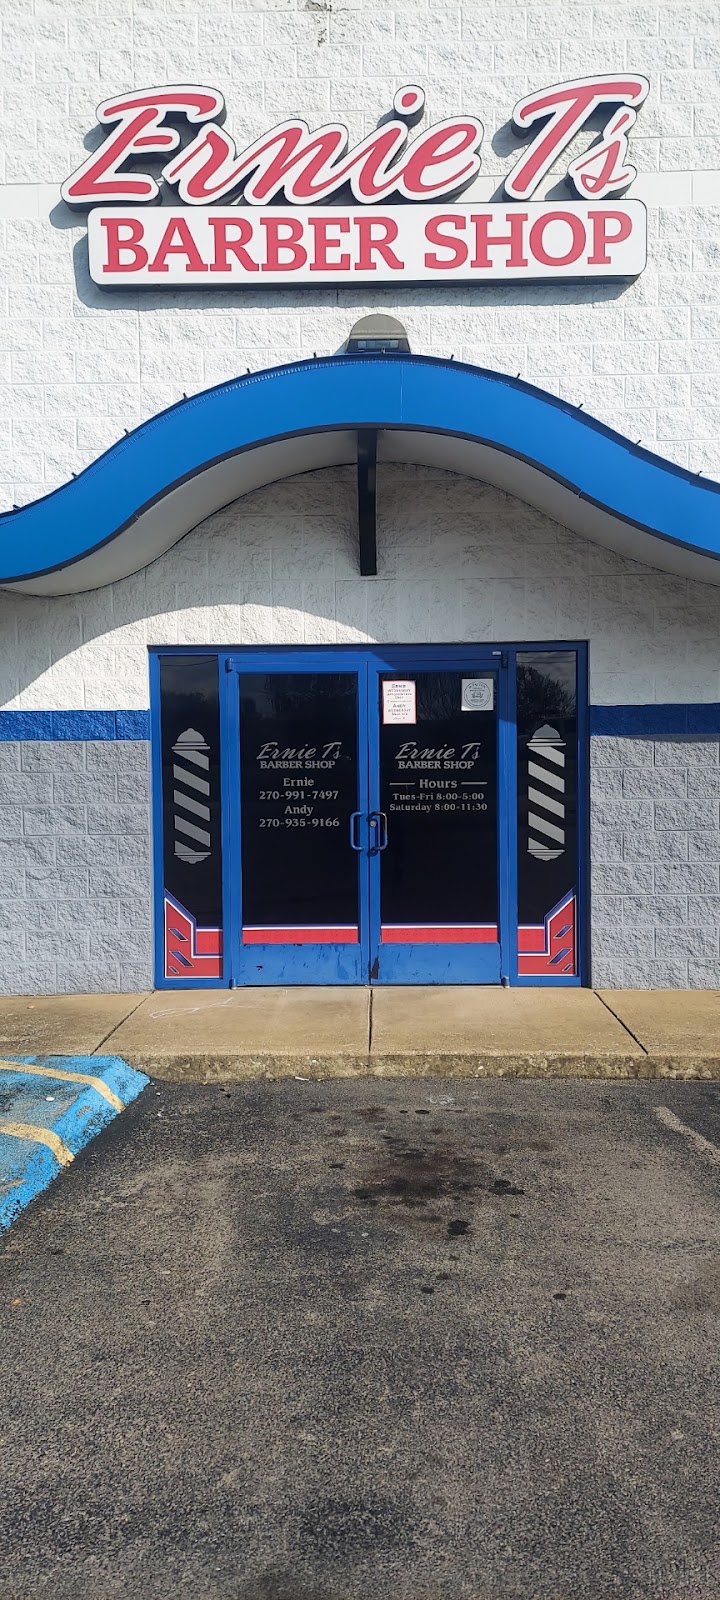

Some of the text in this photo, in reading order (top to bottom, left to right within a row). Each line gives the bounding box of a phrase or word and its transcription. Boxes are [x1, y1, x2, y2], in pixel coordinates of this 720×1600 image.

[64, 85, 484, 204] Ernie
[101, 211, 633, 272] BARBER SHOP
[256, 741, 317, 760] Ernie
[394, 741, 456, 760] Ernie
[259, 760, 336, 769] BARBER SHOP
[397, 760, 475, 770] BARBER SHOP
[282, 777, 315, 787] Ernie
[418, 778, 458, 789] Hours
[259, 790, 339, 800] 270-991-7497
[392, 792, 485, 801] Tues-Fri 8:00-5:00
[284, 804, 314, 817] Andy
[389, 802, 488, 813] Saturday 8:00-11:30
[258, 817, 340, 828] 270-935-9166
